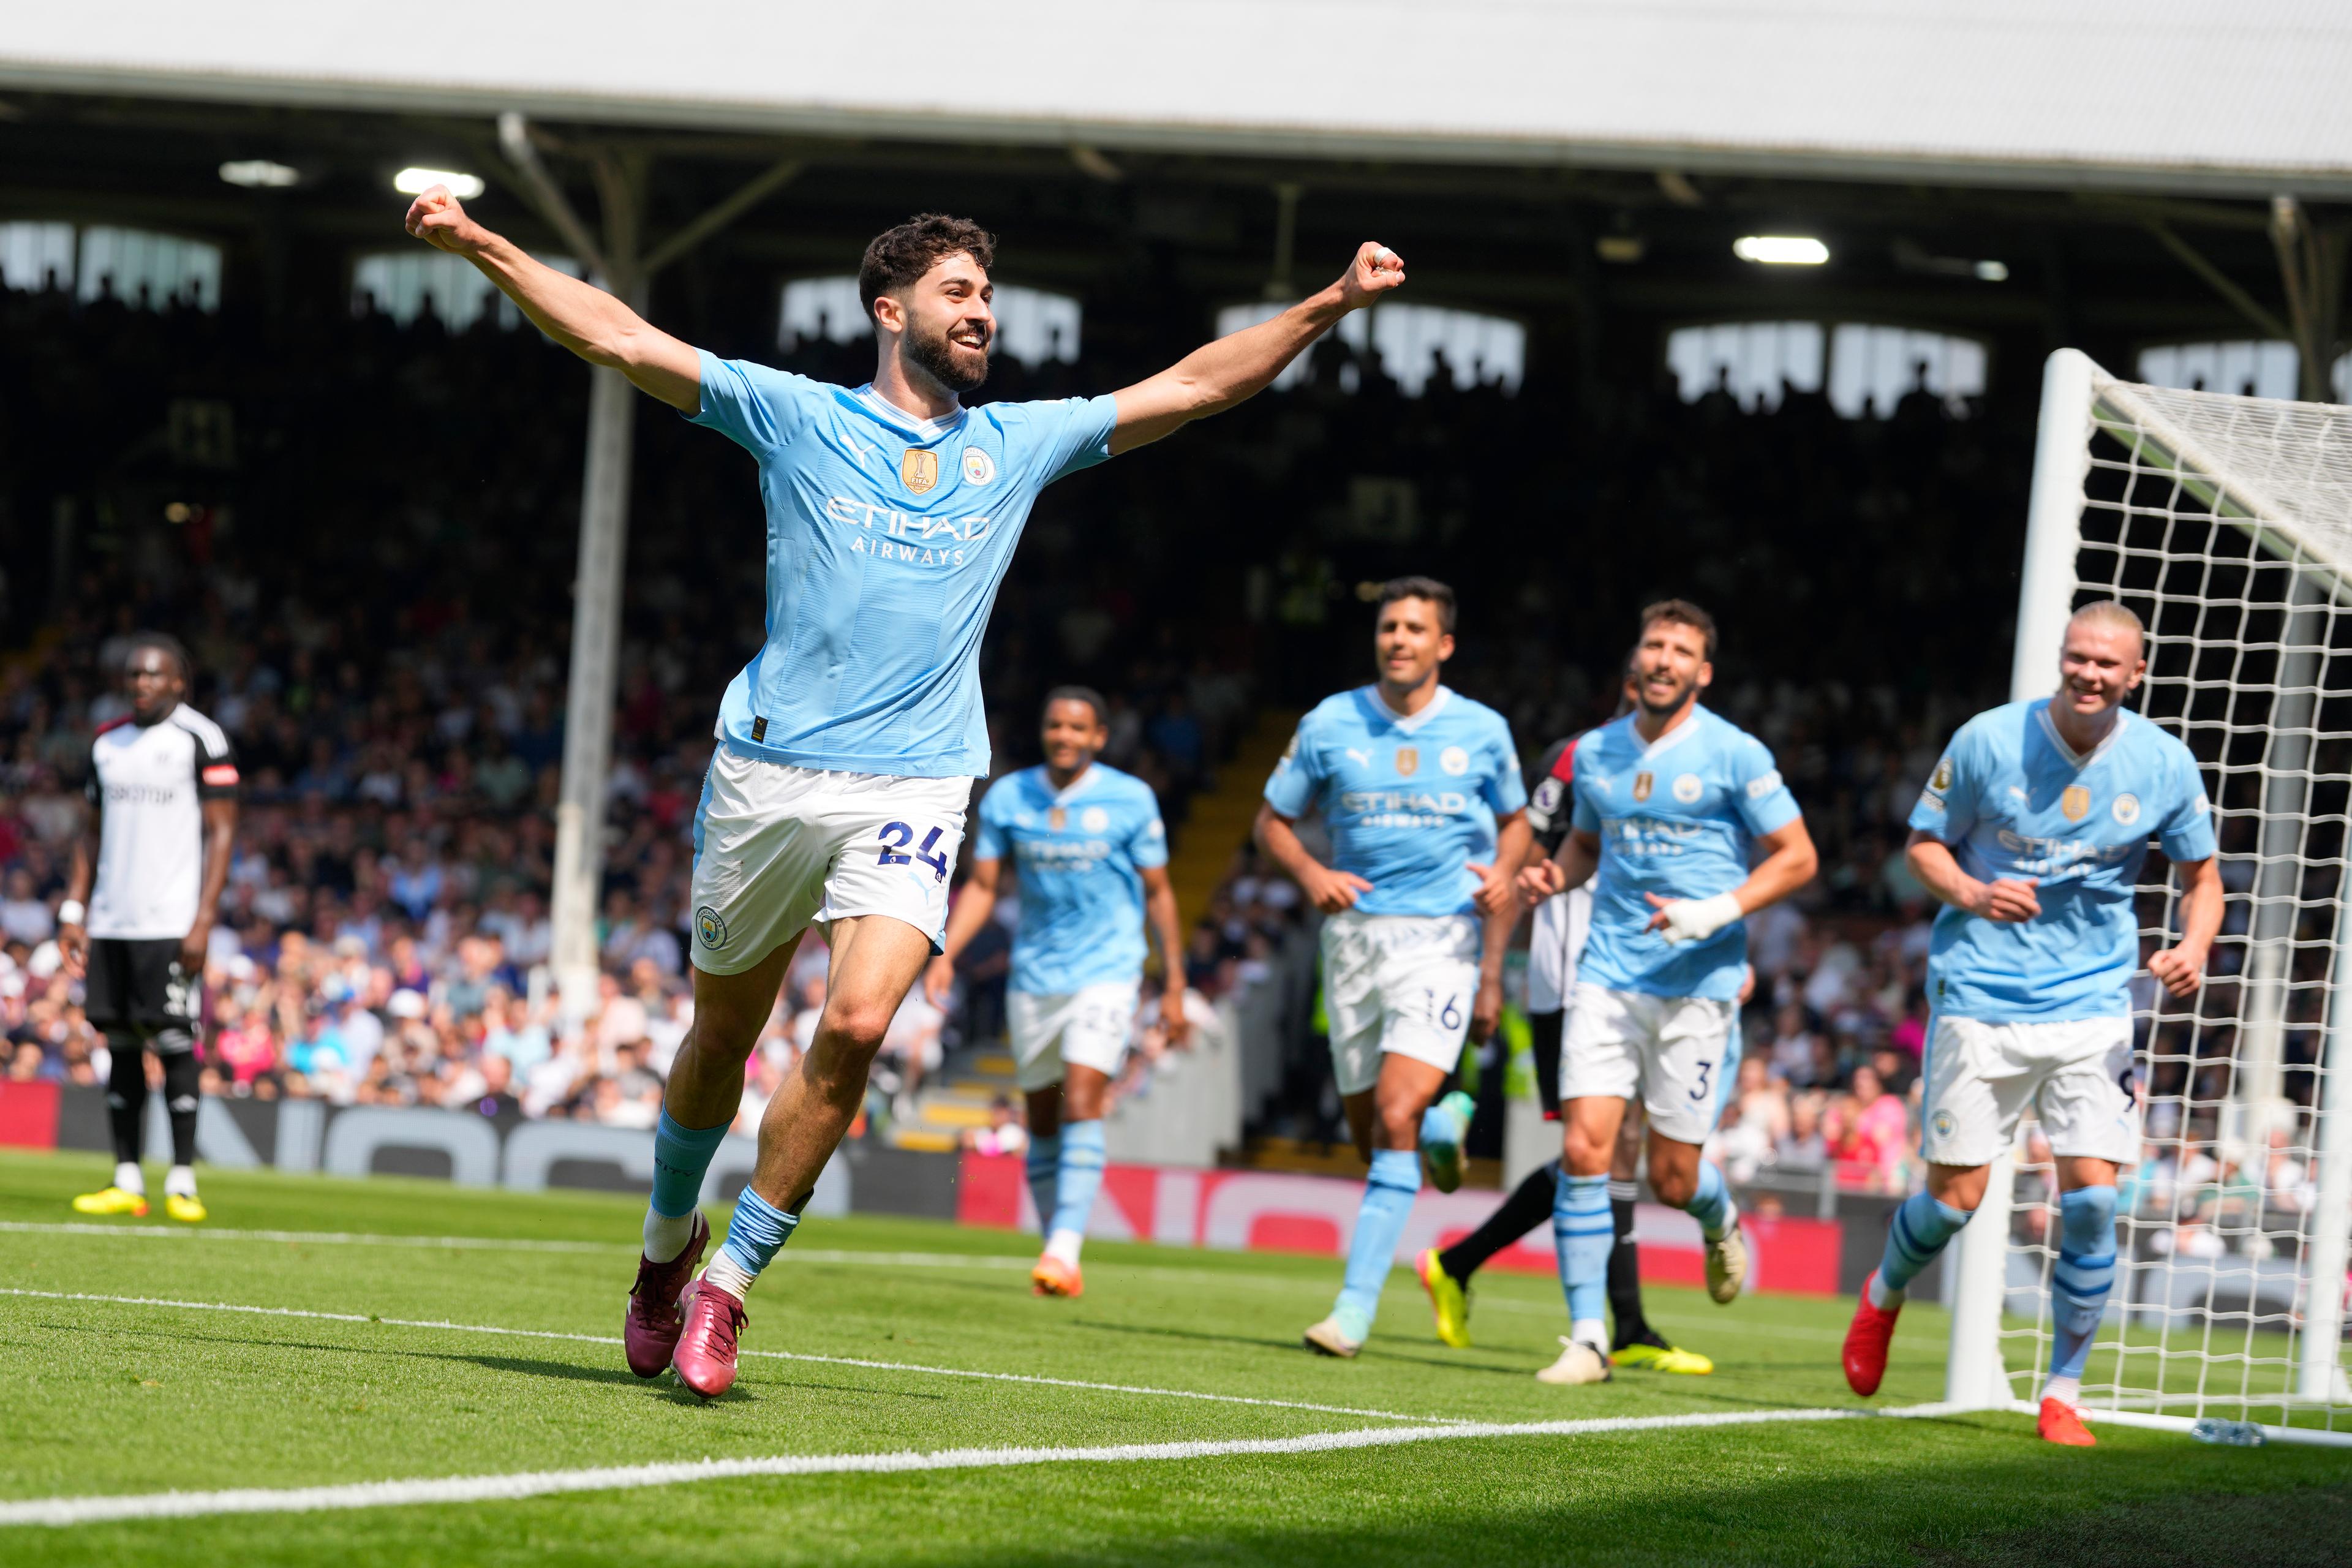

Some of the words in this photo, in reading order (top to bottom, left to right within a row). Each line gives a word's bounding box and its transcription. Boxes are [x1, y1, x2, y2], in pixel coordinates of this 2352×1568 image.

[827, 497, 990, 541] ETIHAD
[851, 535, 964, 566] AIRWAYS
[1342, 792, 1466, 815] ETIHAD
[877, 821, 948, 884] 24
[1998, 829, 2130, 862] ETIHAD
[699, 910, 722, 928] MANCHESTER
[1423, 988, 1461, 1030] 16
[1689, 1061, 1711, 1101] 3
[2119, 1068, 2136, 1112] 9
[655, 1157, 695, 1177] CITY
